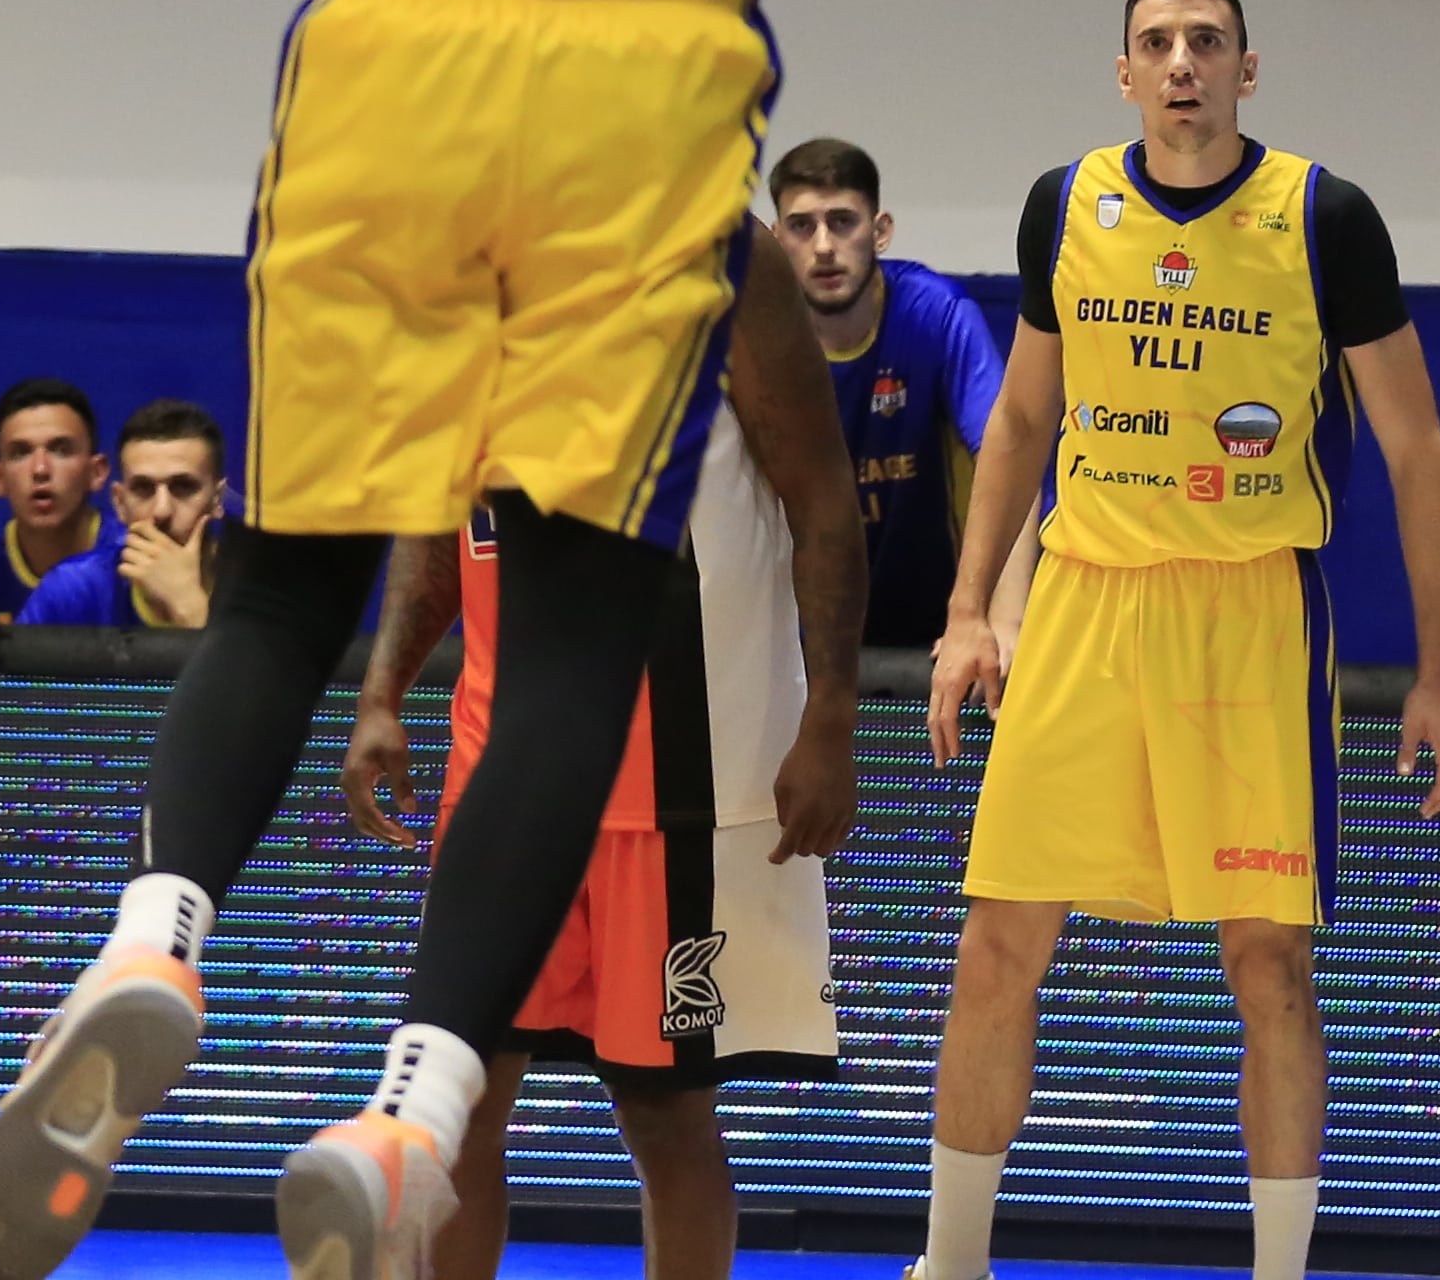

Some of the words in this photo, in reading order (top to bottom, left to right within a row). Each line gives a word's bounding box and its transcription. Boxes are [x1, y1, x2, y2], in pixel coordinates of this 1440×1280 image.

[1161, 269, 1188, 285] YLLI
[1076, 297, 1174, 328] GOLDEN
[1182, 303, 1273, 337] EAGLE
[1129, 335, 1203, 372] YLLI
[1092, 404, 1170, 437] Graniti
[1227, 440, 1266, 458] DAUTI
